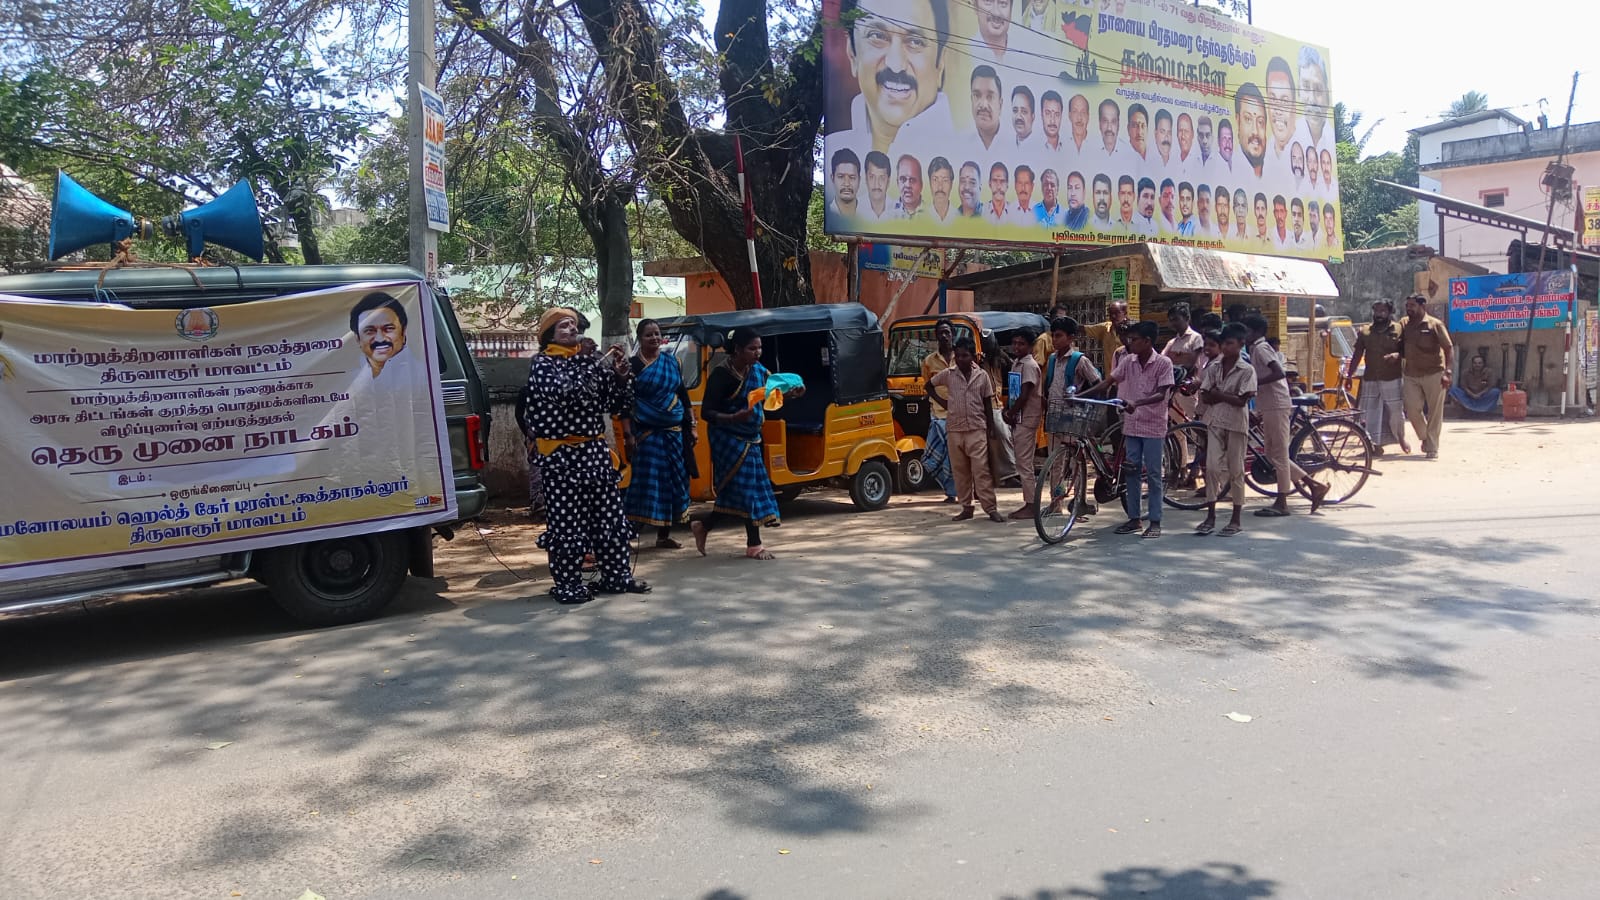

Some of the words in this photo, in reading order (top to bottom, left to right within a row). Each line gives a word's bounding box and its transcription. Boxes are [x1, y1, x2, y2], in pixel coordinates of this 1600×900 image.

[1169, 5, 1178, 15] 71
[1098, 13, 1145, 37] நாளைய
[1148, 20, 1193, 54] பிரதமரை
[1052, 231, 1095, 244] புலிவலம்
[1097, 232, 1136, 244] ஊராட்சி
[34, 344, 242, 366] மாற்றுத்திறனாளிகள்
[247, 338, 343, 357] நலத்துறை
[100, 363, 200, 384] திருவாரூர்
[205, 358, 292, 377] மாவட்டம்
[70, 385, 230, 406] மாற்றுத்திறனாளிகள்
[234, 380, 314, 398] நலனுக்காக
[29, 413, 70, 425] அரசு
[74, 406, 154, 424] திட்டங்கள்
[158, 403, 213, 418] குறித்து
[217, 392, 350, 412] பொதுமக்களிடையே
[100, 420, 198, 438] விழிப்புணர்வு
[201, 411, 295, 431] ஏற்படுத்துதல்
[31, 445, 123, 469] தெரு
[133, 435, 236, 462] முனை
[243, 416, 359, 453] நாடகம்
[118, 472, 146, 486] இடம்
[170, 479, 250, 501] ஒருங்கிணைப்பு
[0, 510, 112, 537] மனோலயம்
[117, 502, 190, 527] ஹெல்த்
[194, 498, 230, 517] கேர்
[130, 517, 221, 546] திருவாரூர்
[226, 506, 307, 532] மாவட்டம்
